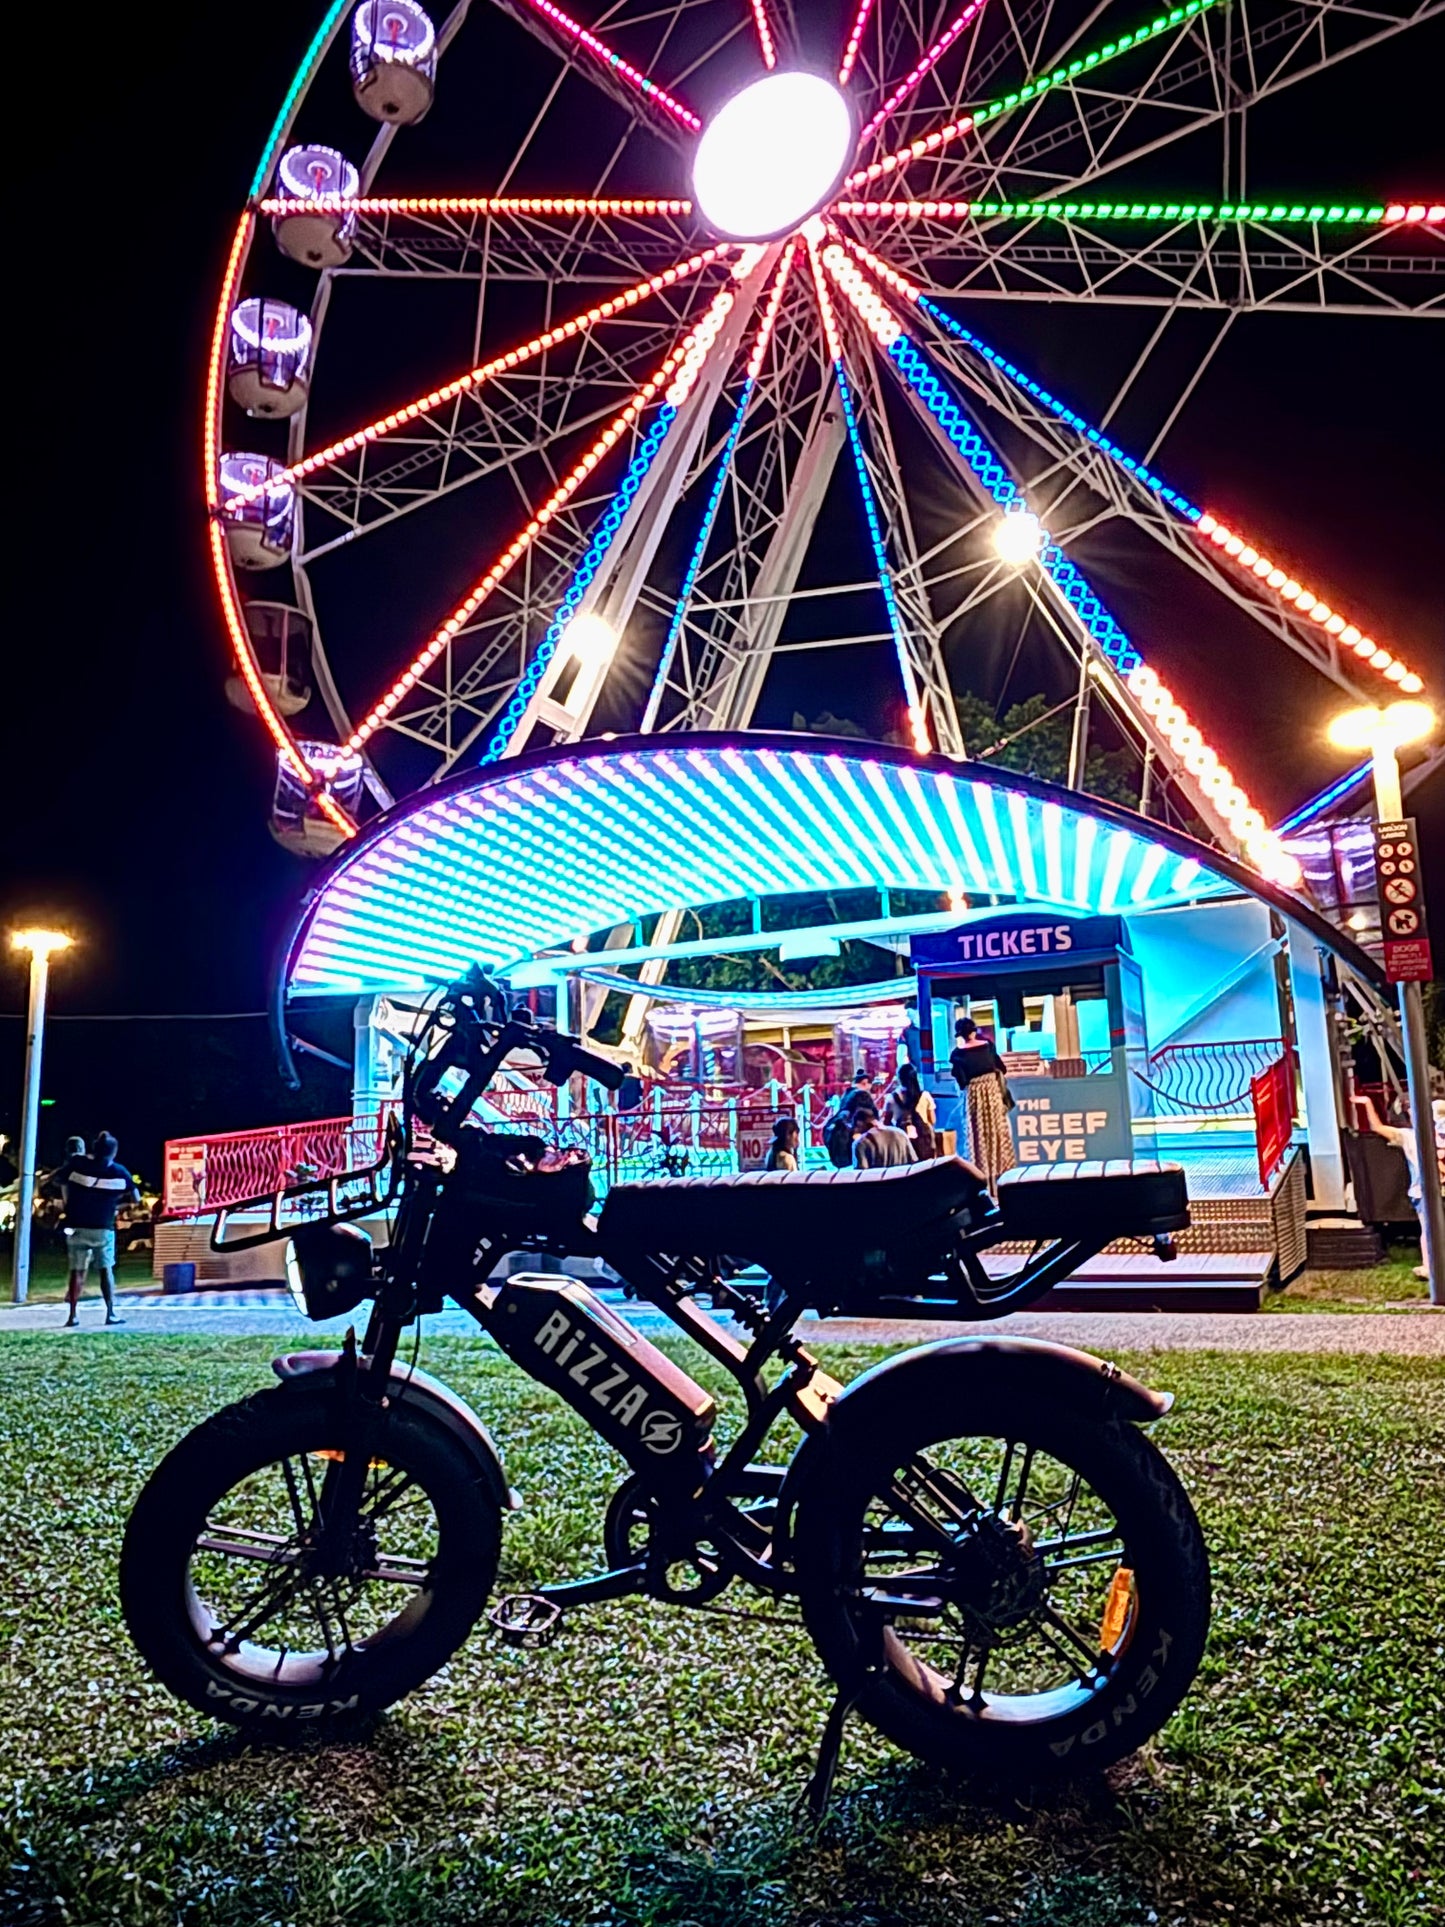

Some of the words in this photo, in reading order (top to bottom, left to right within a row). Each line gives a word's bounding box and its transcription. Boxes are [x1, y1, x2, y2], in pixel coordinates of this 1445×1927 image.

[958, 925, 1072, 959] TICKETS
[1393, 944, 1420, 954] DOGS
[1016, 1098, 1051, 1111] THE
[1016, 1111, 1107, 1137] REEF
[742, 1139, 761, 1158] NO
[1018, 1138, 1086, 1162] EYE
[171, 1167, 183, 1183] NO
[206, 1680, 359, 1719] KENDA
[1049, 1627, 1173, 1757] KENDA
